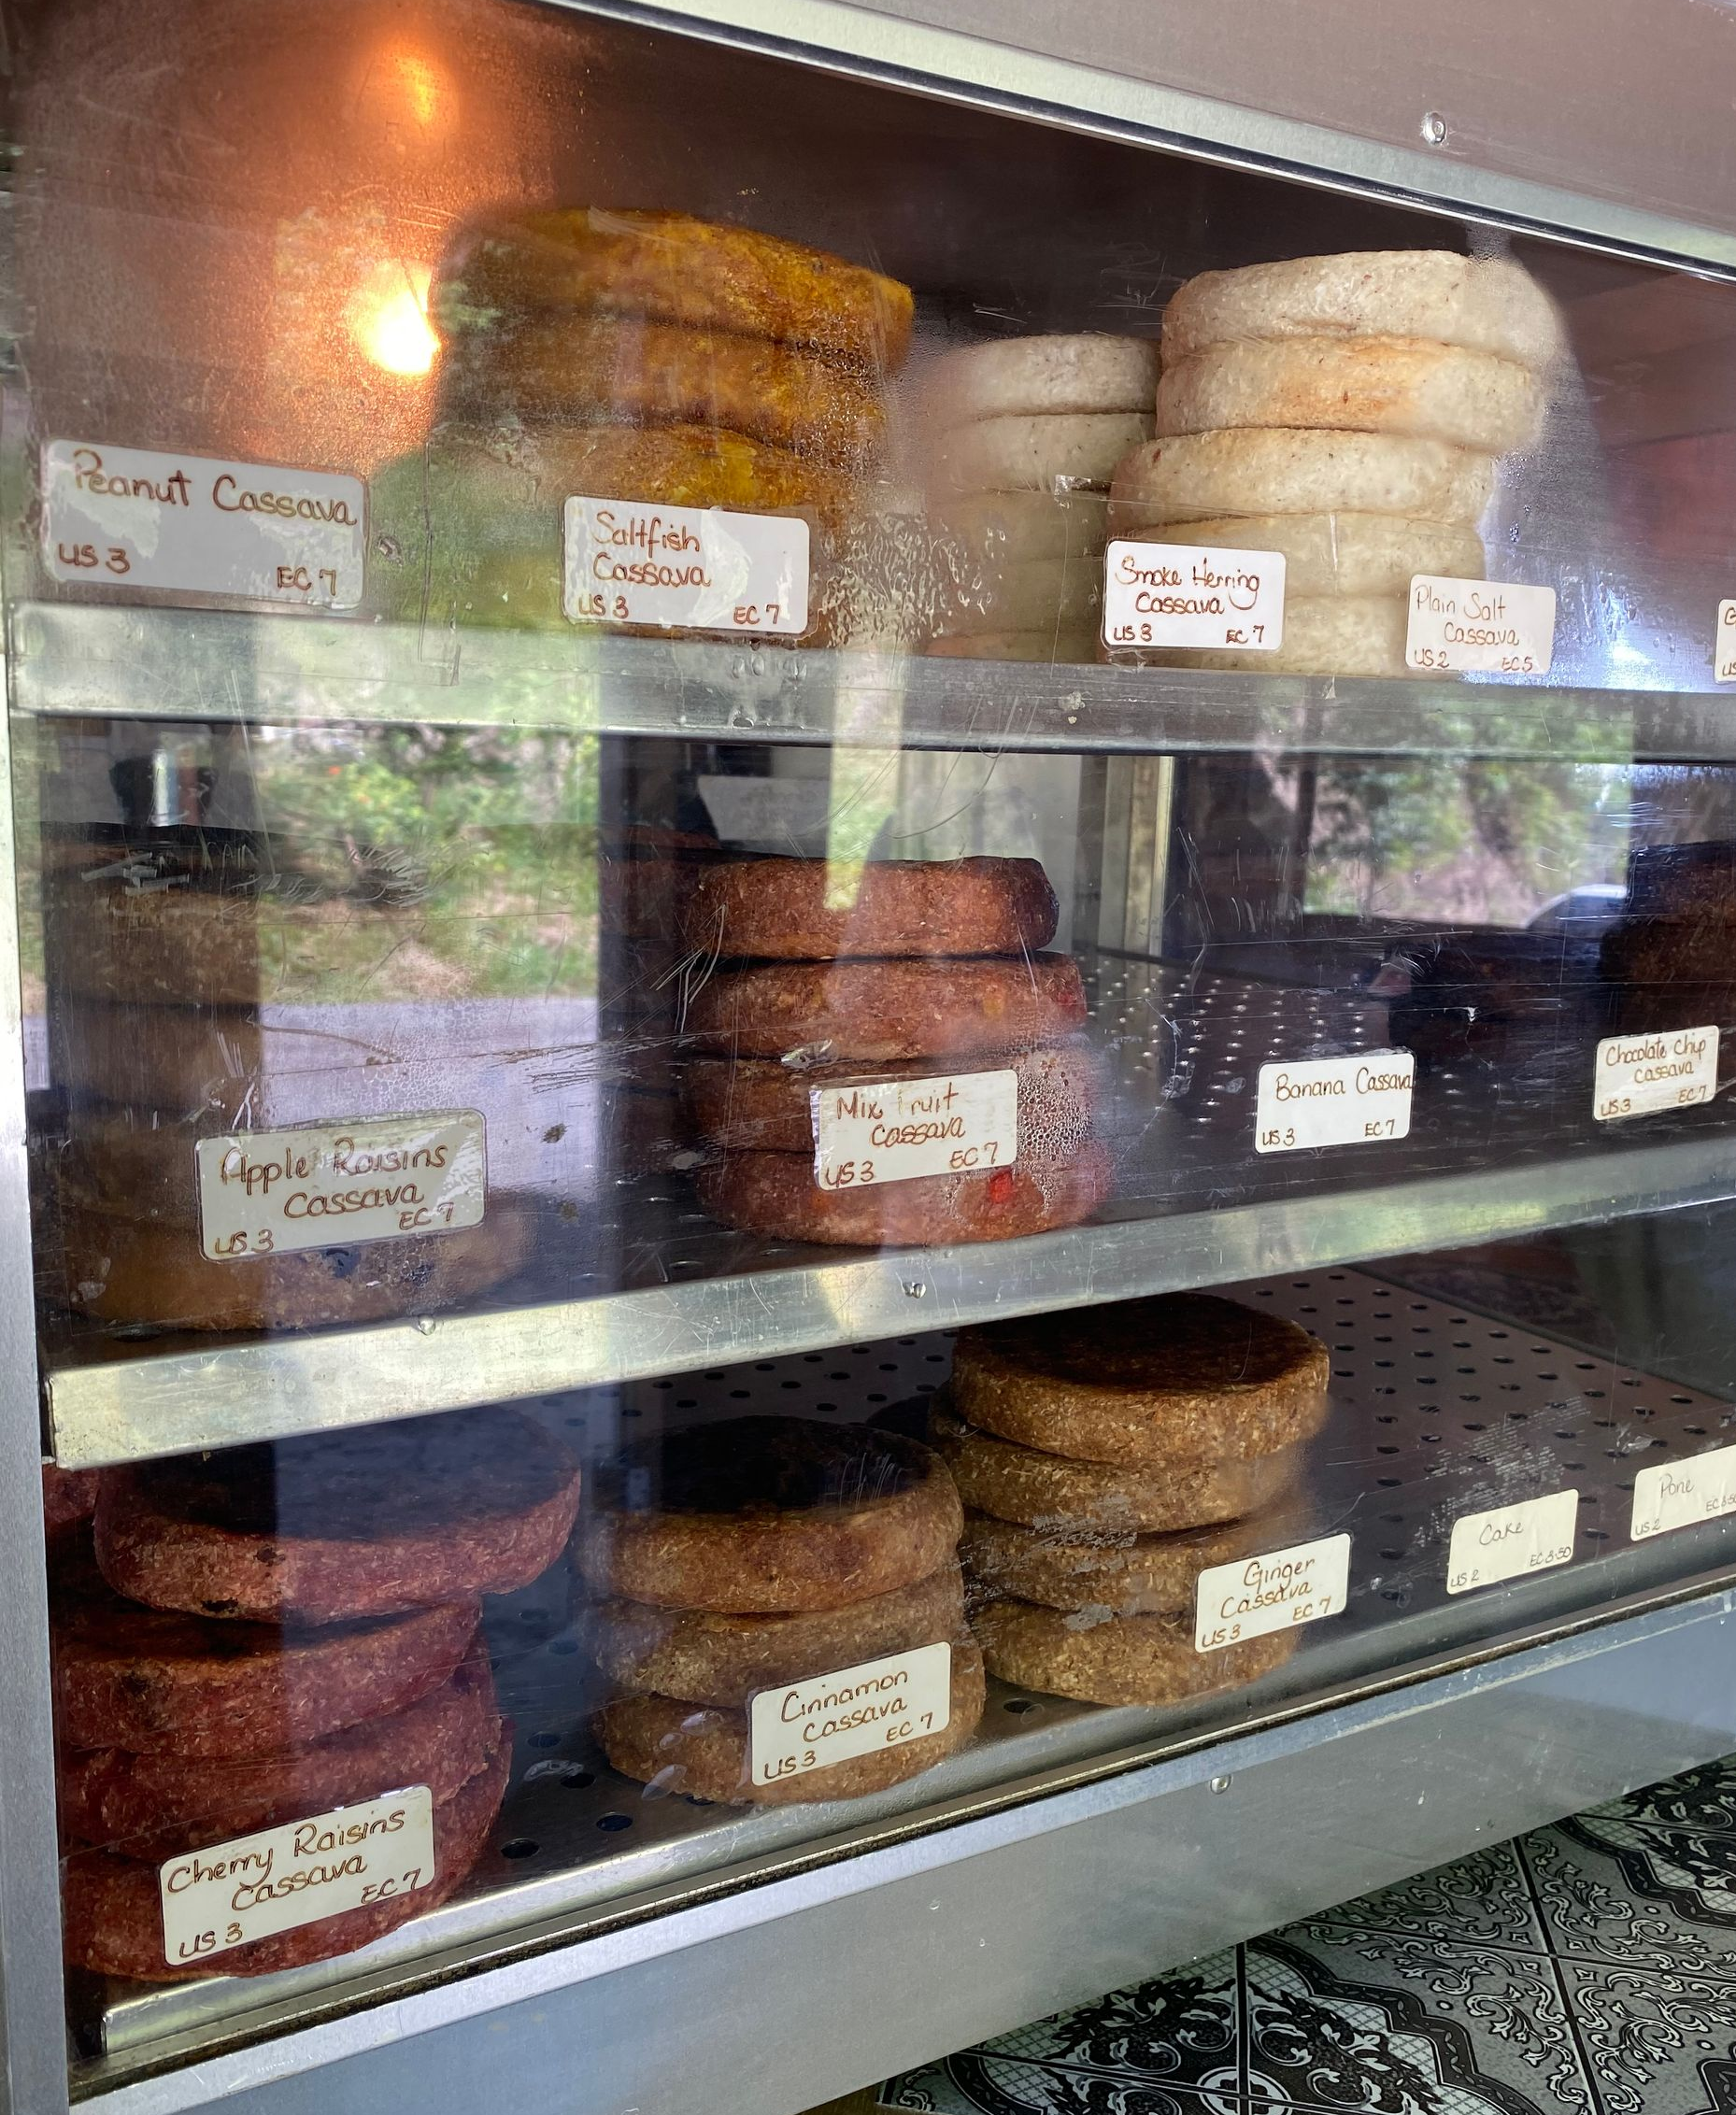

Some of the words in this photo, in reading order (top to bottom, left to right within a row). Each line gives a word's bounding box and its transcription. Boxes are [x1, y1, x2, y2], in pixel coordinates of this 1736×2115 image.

[74, 449, 192, 506] Peanut
[212, 474, 358, 526] Cassava
[591, 511, 700, 559] Saltfish
[58, 543, 98, 568] US
[106, 547, 130, 574] 3
[593, 552, 710, 588] Cassava
[277, 566, 312, 591] EC
[320, 569, 337, 596] 7
[1115, 555, 1182, 586] Smoke
[1192, 557, 1259, 610] Herring
[578, 594, 605, 617] US
[613, 595, 629, 618] 3
[733, 605, 761, 625] EC
[765, 603, 780, 625] 7
[1135, 591, 1225, 615] Cassava
[1416, 585, 1456, 614] Plain
[1464, 592, 1506, 620] Salt
[1114, 625, 1135, 641] US
[1226, 630, 1248, 644] EC
[1253, 625, 1265, 643] 7
[1444, 622, 1520, 646] Cassava
[1415, 648, 1434, 667] US
[1437, 651, 1449, 669] 2
[1501, 657, 1519, 671] EC
[1522, 657, 1532, 672] 5
[1606, 1036, 1667, 1066] Chocolate
[1275, 1073, 1345, 1101] Banana
[1356, 1067, 1413, 1095] Cassava
[1677, 1088, 1697, 1103] EC
[1699, 1086, 1707, 1100] 7
[836, 1091, 883, 1120] Mix
[1601, 1099, 1619, 1116] US
[1620, 1099, 1630, 1113] 3
[871, 1116, 966, 1148] Cassava
[1262, 1129, 1281, 1146] US
[1283, 1128, 1295, 1146] 3
[1365, 1122, 1383, 1137] EC
[1386, 1119, 1396, 1136] 7
[221, 1146, 310, 1195] Apple
[333, 1137, 448, 1177] Raisins
[949, 1147, 978, 1170] EC
[984, 1142, 998, 1165] 7
[825, 1161, 855, 1187] US
[860, 1160, 875, 1182] 3
[284, 1183, 424, 1218] Cassava
[399, 1207, 431, 1230] EC
[436, 1202, 454, 1222] 7
[215, 1231, 247, 1254] US
[251, 1229, 274, 1252] 3
[1659, 1473, 1695, 1498] Pone
[1705, 1498, 1719, 1512] EC
[1479, 1522, 1524, 1545] Cake
[1635, 1522, 1650, 1536] US
[1652, 1518, 1661, 1530] 2
[1530, 1552, 1544, 1567] EC
[1244, 1558, 1315, 1595] Ginger
[1450, 1572, 1467, 1587] US
[1471, 1569, 1480, 1583] 2
[1220, 1582, 1313, 1619] Cassava
[1292, 1604, 1313, 1622] EC
[1319, 1596, 1331, 1614] 7
[1202, 1628, 1227, 1648] US
[1230, 1624, 1242, 1639] 3
[781, 1670, 908, 1723] Cinnamon
[804, 1697, 908, 1742] Cassava
[886, 1721, 914, 1742] EC
[920, 1711, 933, 1729] 7
[764, 1755, 797, 1780] US
[801, 1750, 817, 1767] 3
[167, 1848, 273, 1894] Cherry
[294, 1810, 406, 1857] Raisins
[231, 1854, 368, 1911] Cassava
[361, 1879, 398, 1905] EC
[403, 1868, 421, 1891] 7
[179, 1931, 216, 1958] US
[225, 1923, 243, 1944] 3
